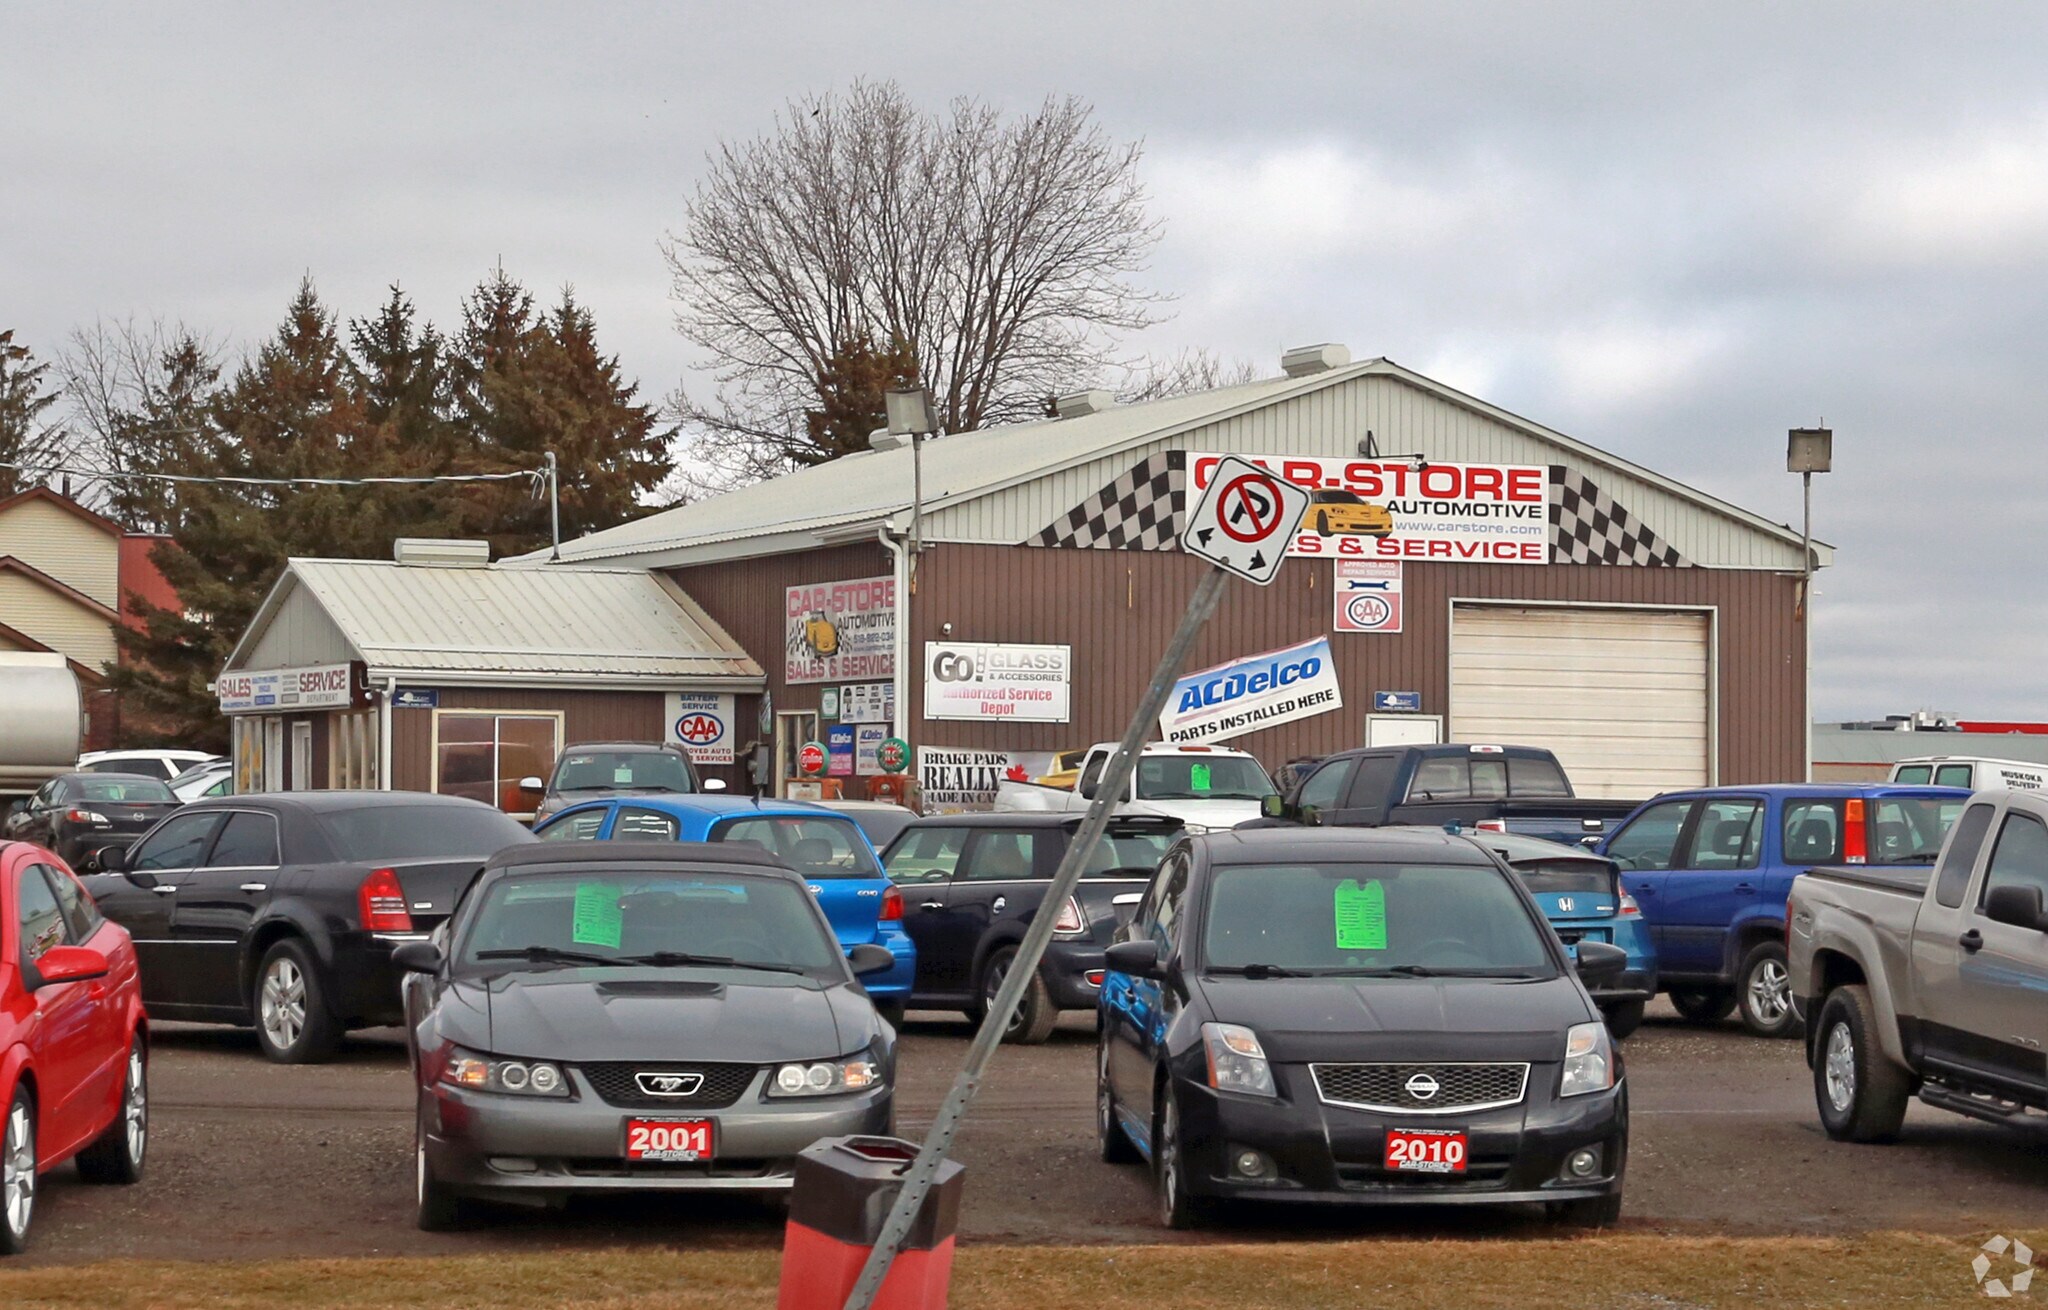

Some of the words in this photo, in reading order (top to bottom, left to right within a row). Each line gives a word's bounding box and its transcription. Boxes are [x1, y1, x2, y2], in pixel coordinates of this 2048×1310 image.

[1386, 500, 1542, 519] AUTOMOTIVE
[1395, 521, 1542, 536] www.carstore.com
[1338, 537, 1364, 554] &
[1376, 537, 1542, 560] SERVICE
[1353, 600, 1383, 621] CAA
[787, 660, 825, 681] SALES
[829, 658, 838, 678] &
[842, 653, 895, 677] SERVICE
[989, 652, 1063, 670] GLASS
[299, 669, 346, 693] SERVICE
[998, 673, 1063, 682] ACCESSORIES
[1177, 657, 1321, 714] ACDelco
[221, 678, 251, 699] SALES
[680, 693, 720, 702] BATTERY
[1008, 687, 1053, 701] Service
[980, 702, 1015, 716] Depot
[1170, 721, 1218, 743] PARTS
[1220, 699, 1296, 730] INSTALLED
[1298, 688, 1335, 710] HERE
[680, 715, 718, 741] CAA
[924, 753, 972, 765] BRAKE
[974, 754, 1008, 766] PADS
[924, 766, 1001, 791] REALLY
[2000, 769, 2043, 783] MUSKOKA
[961, 792, 974, 803] IN
[629, 1127, 706, 1151] 2001
[1389, 1138, 1464, 1164] 2010
